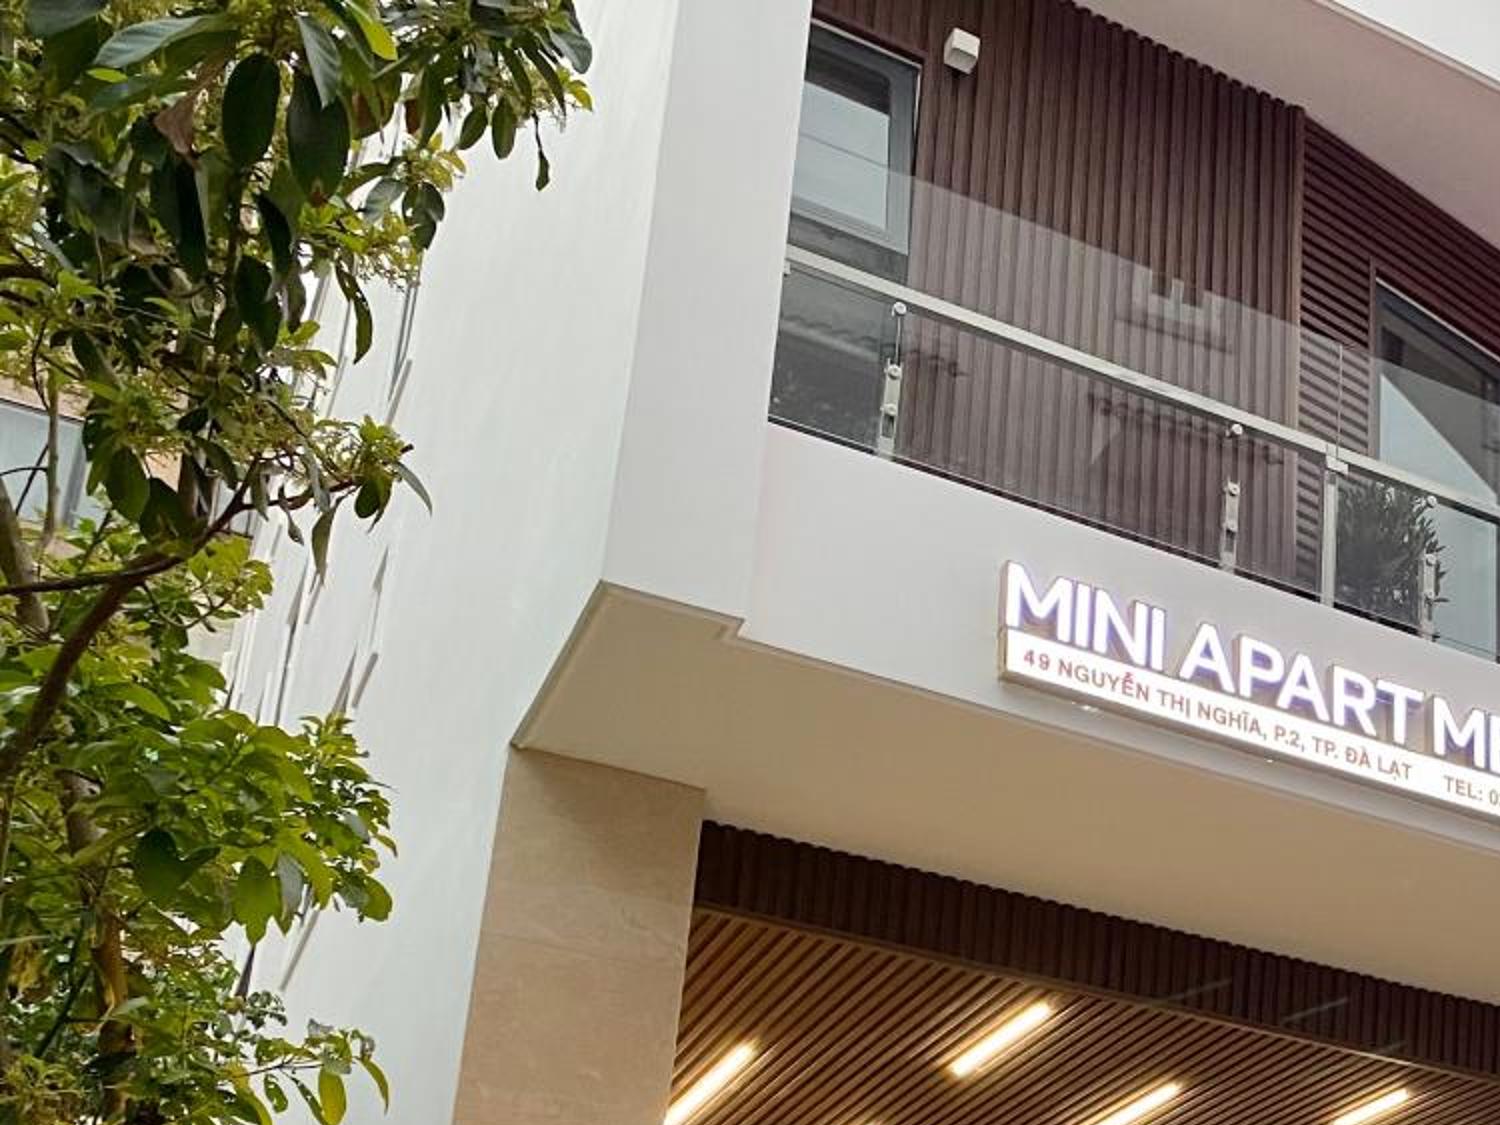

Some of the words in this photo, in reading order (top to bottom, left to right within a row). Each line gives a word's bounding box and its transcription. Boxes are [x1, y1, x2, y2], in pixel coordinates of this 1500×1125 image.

[1004, 559, 1167, 671] MINI
[1023, 650, 1051, 671] 49
[1057, 658, 1150, 703] NGUYỄN
[1156, 688, 1191, 719] THỊ
[1197, 702, 1268, 741] NGHĨA,
[1311, 735, 1339, 760] TP.
[1344, 745, 1372, 770] ĐÀ
[1377, 758, 1413, 783] LẠT
[1443, 774, 1484, 802] TEL:
